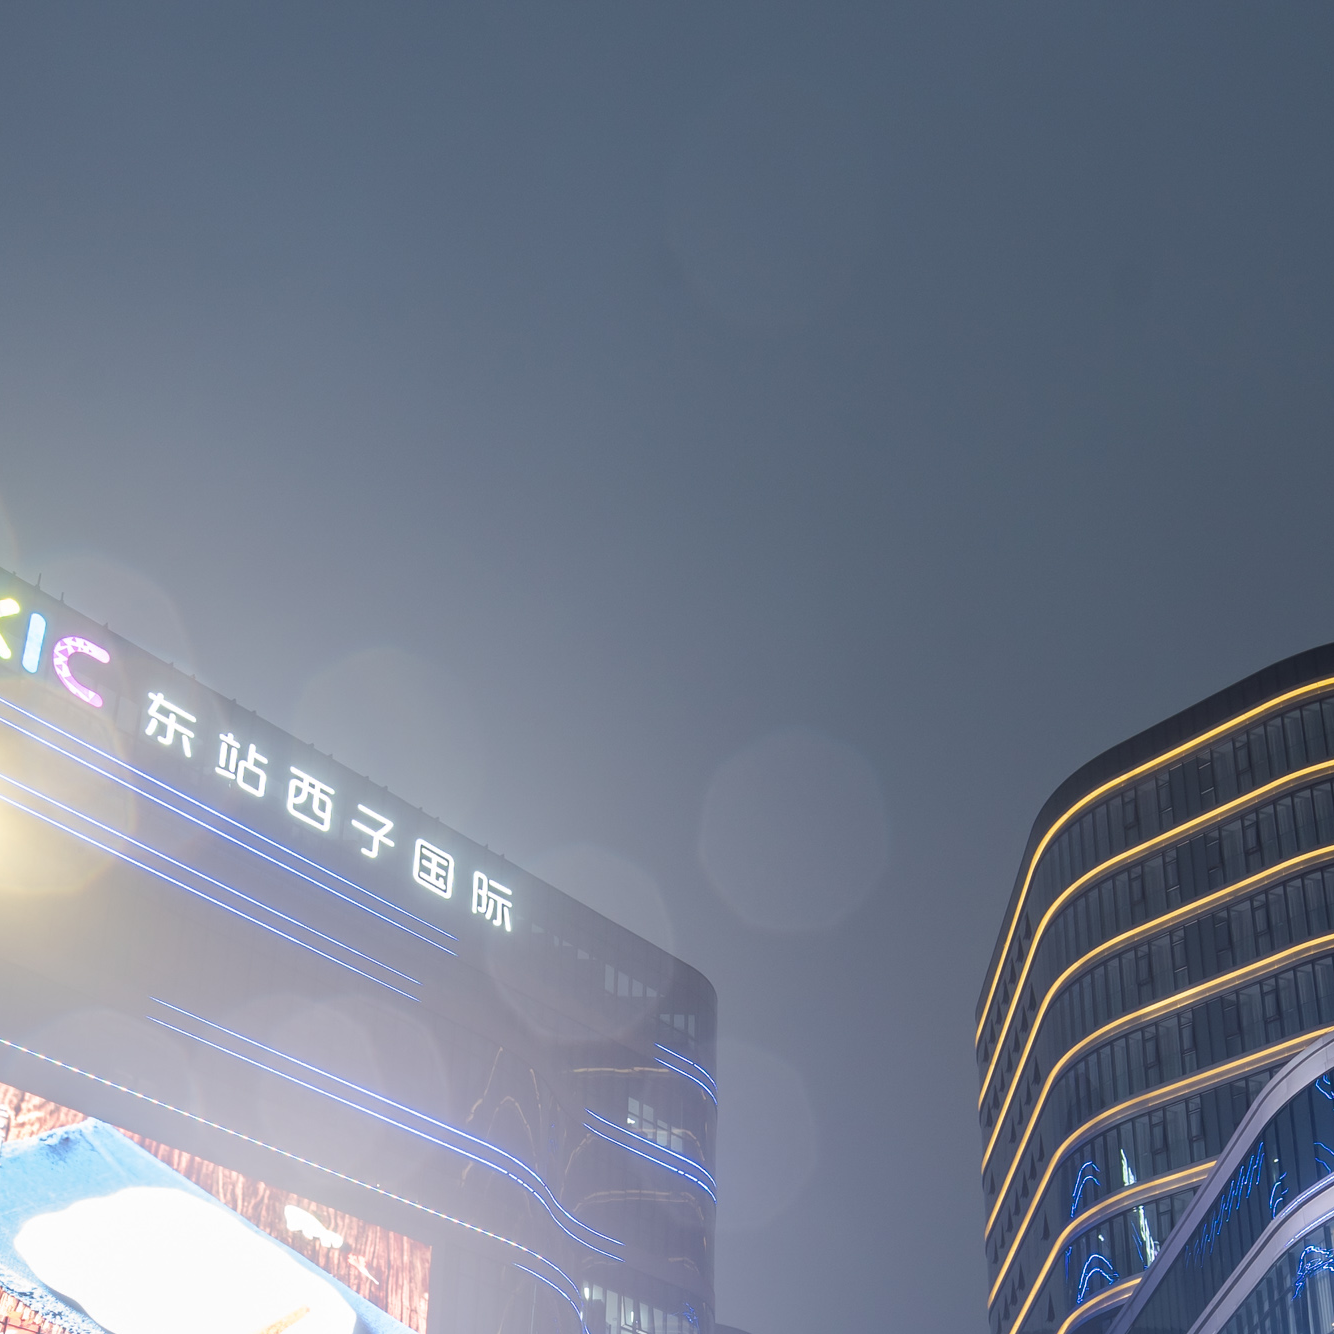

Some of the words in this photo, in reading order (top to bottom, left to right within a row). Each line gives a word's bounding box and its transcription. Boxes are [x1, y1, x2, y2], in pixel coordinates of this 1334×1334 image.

[143, 690, 515, 933] 东站西子国际
